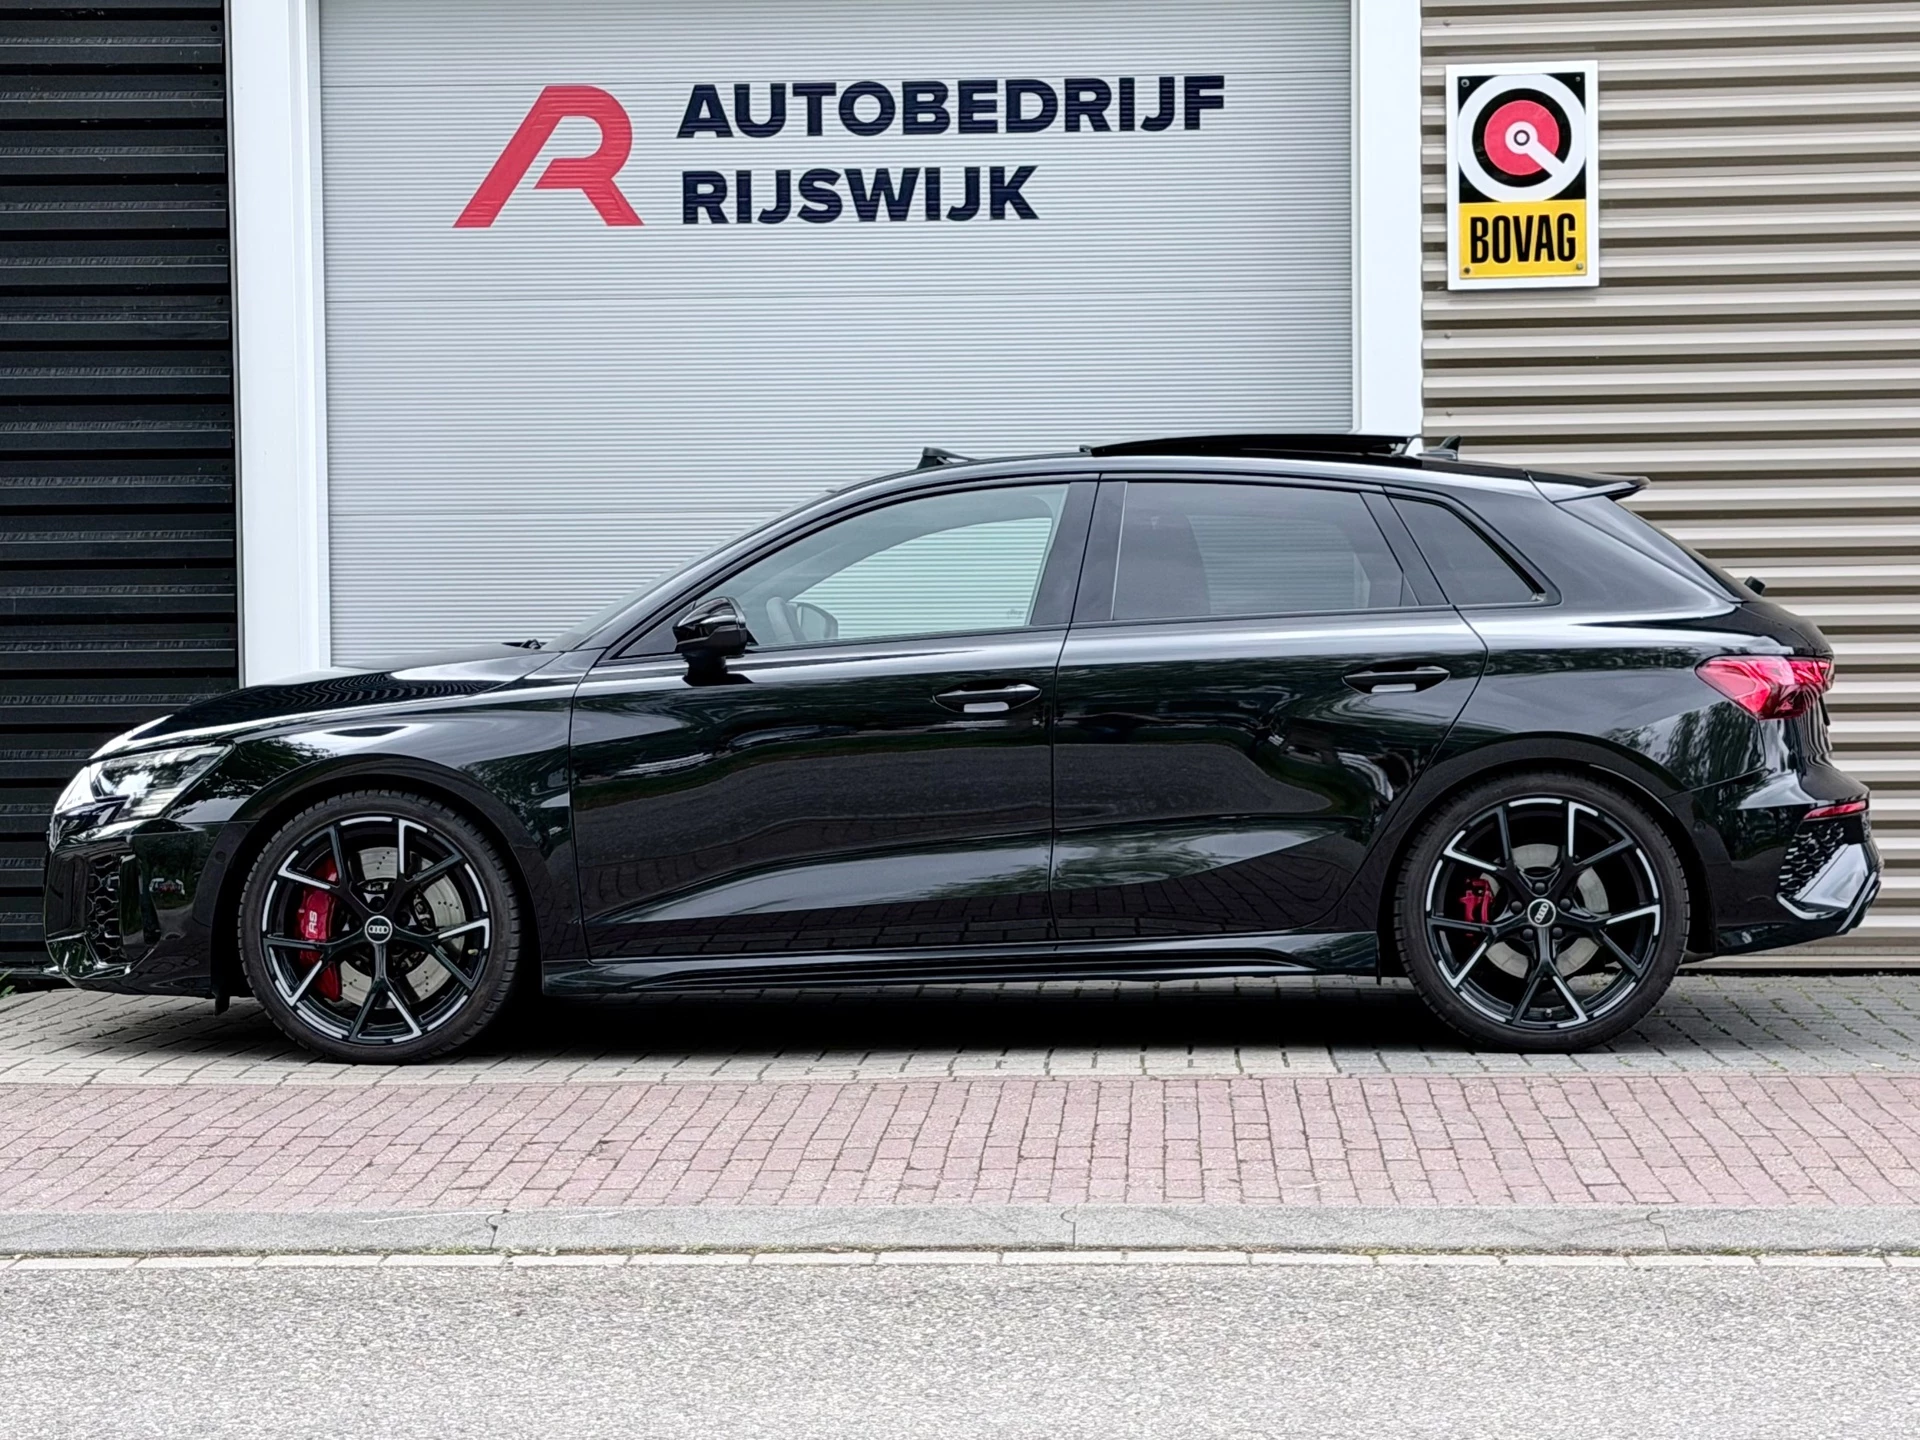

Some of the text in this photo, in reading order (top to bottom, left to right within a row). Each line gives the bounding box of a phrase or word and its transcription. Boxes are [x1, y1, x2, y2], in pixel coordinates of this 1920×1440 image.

[677, 75, 1225, 139] AUTOBEDRIJF
[683, 165, 1040, 225] RIJSWIJK
[1470, 213, 1576, 264] BOVAG
[308, 910, 318, 935] RS
